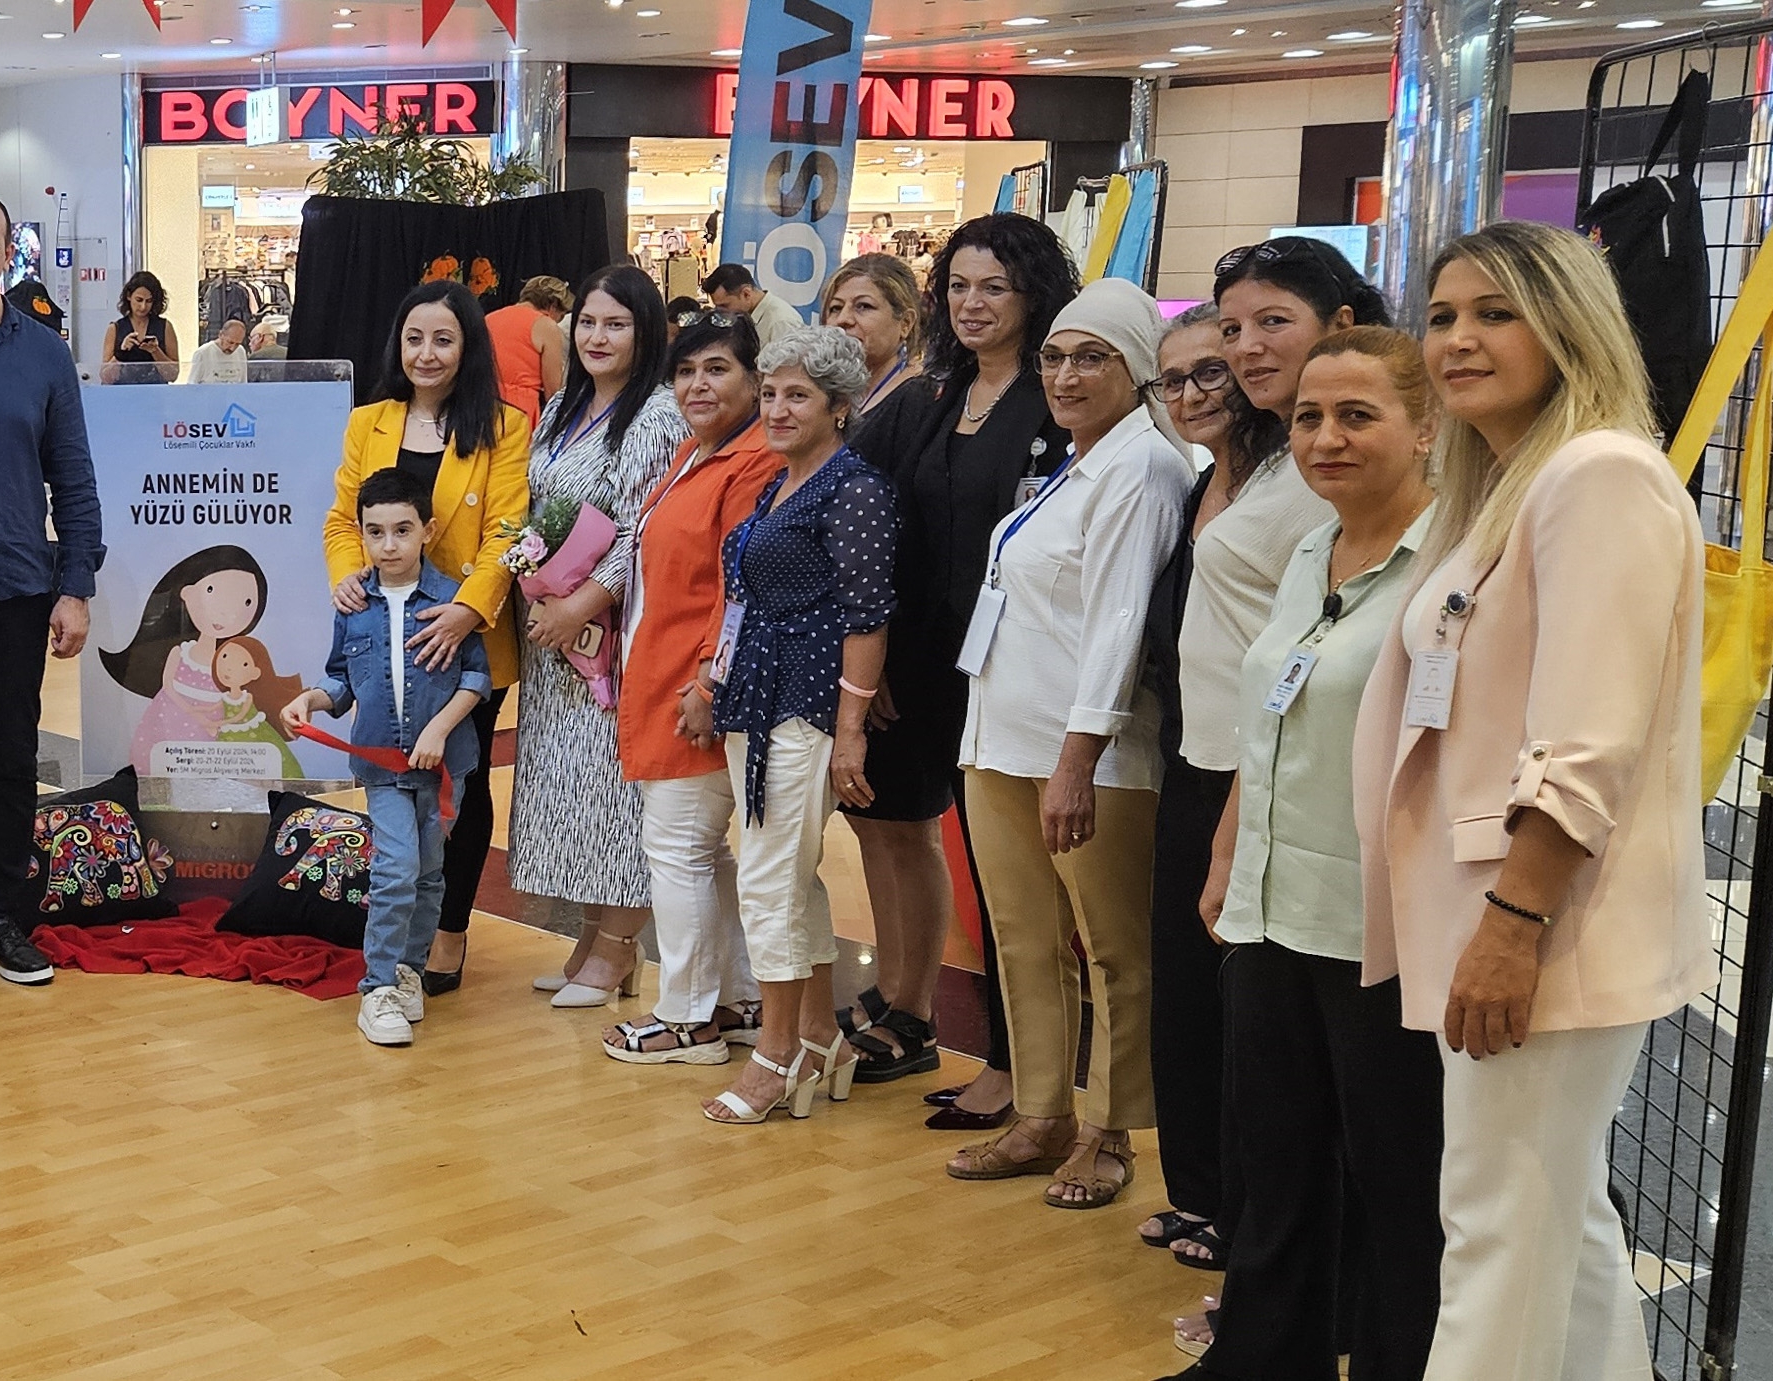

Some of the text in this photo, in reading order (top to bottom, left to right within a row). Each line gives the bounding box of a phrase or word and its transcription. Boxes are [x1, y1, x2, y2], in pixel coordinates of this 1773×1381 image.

[160, 82, 478, 141] BOYNER
[714, 73, 1015, 138] BNER
[743, 0, 854, 326] ÖSEV
[163, 421, 228, 438] LÖSEV
[199, 440, 234, 451] Çocuklar
[142, 467, 280, 494] ANNEMİN DE
[130, 499, 293, 525] YÜZÜ GÜLÜYOR
